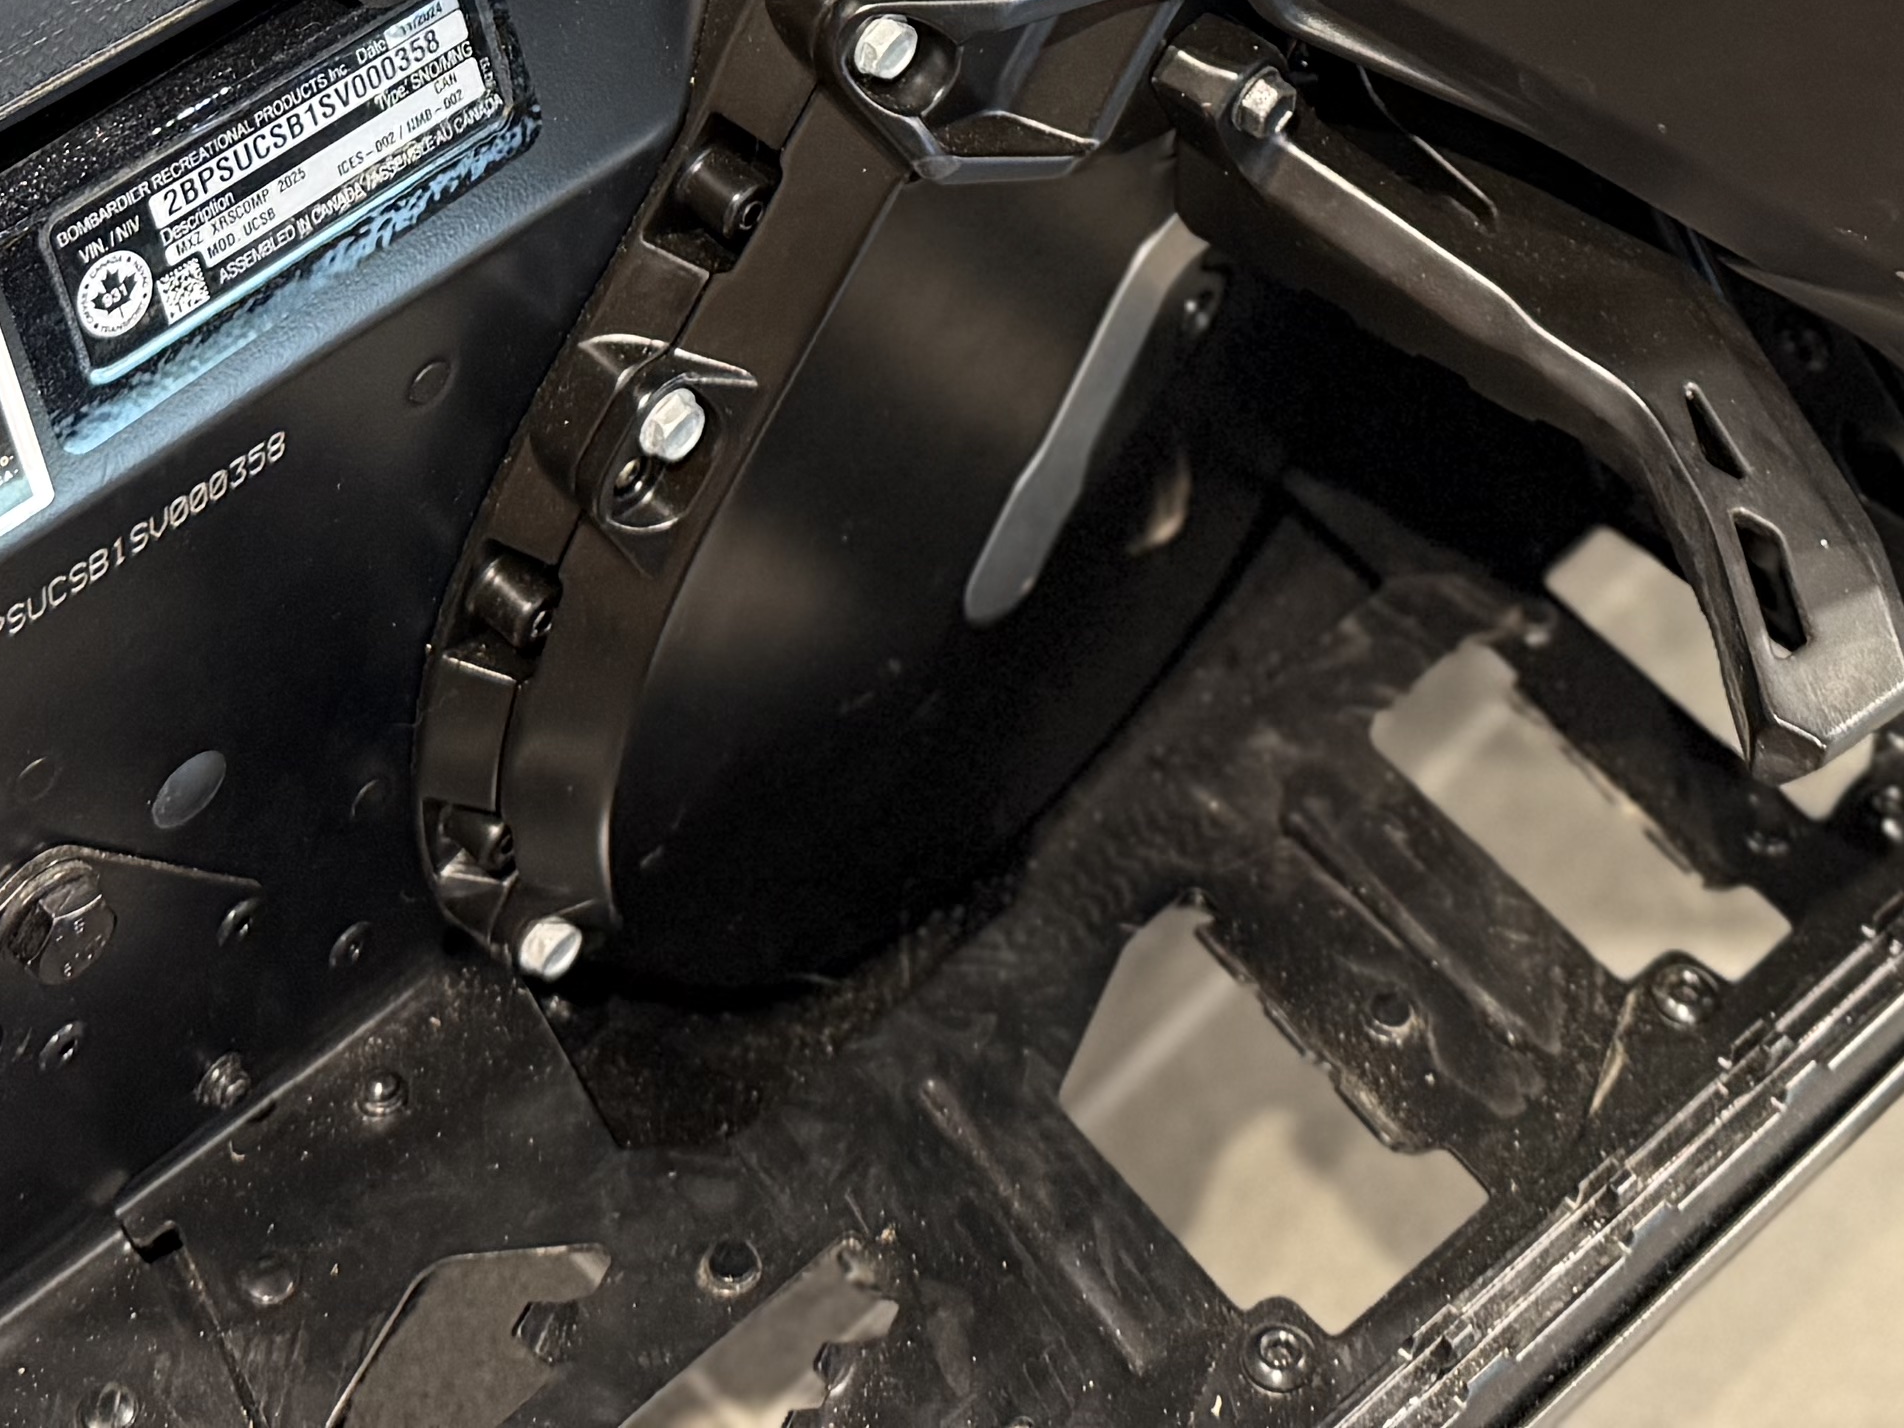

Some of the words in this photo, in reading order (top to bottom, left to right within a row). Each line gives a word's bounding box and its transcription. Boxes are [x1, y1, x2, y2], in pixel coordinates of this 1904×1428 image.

[354, 34, 388, 66] Date
[407, 40, 474, 91] SNO/MNG
[432, 70, 459, 95] CAN
[159, 27, 444, 217] 2BPSUCSB1SV000358
[55, 181, 152, 249] BOMBARDIER
[152, 116, 257, 189] RECREATIONAL
[252, 71, 329, 127] PRODUCTS
[159, 188, 236, 247] Description
[173, 229, 204, 257] MXZ
[208, 187, 272, 235] XRSCOMP
[276, 165, 307, 193] 2025
[205, 228, 242, 260] MOD.
[242, 206, 277, 237] UCSB
